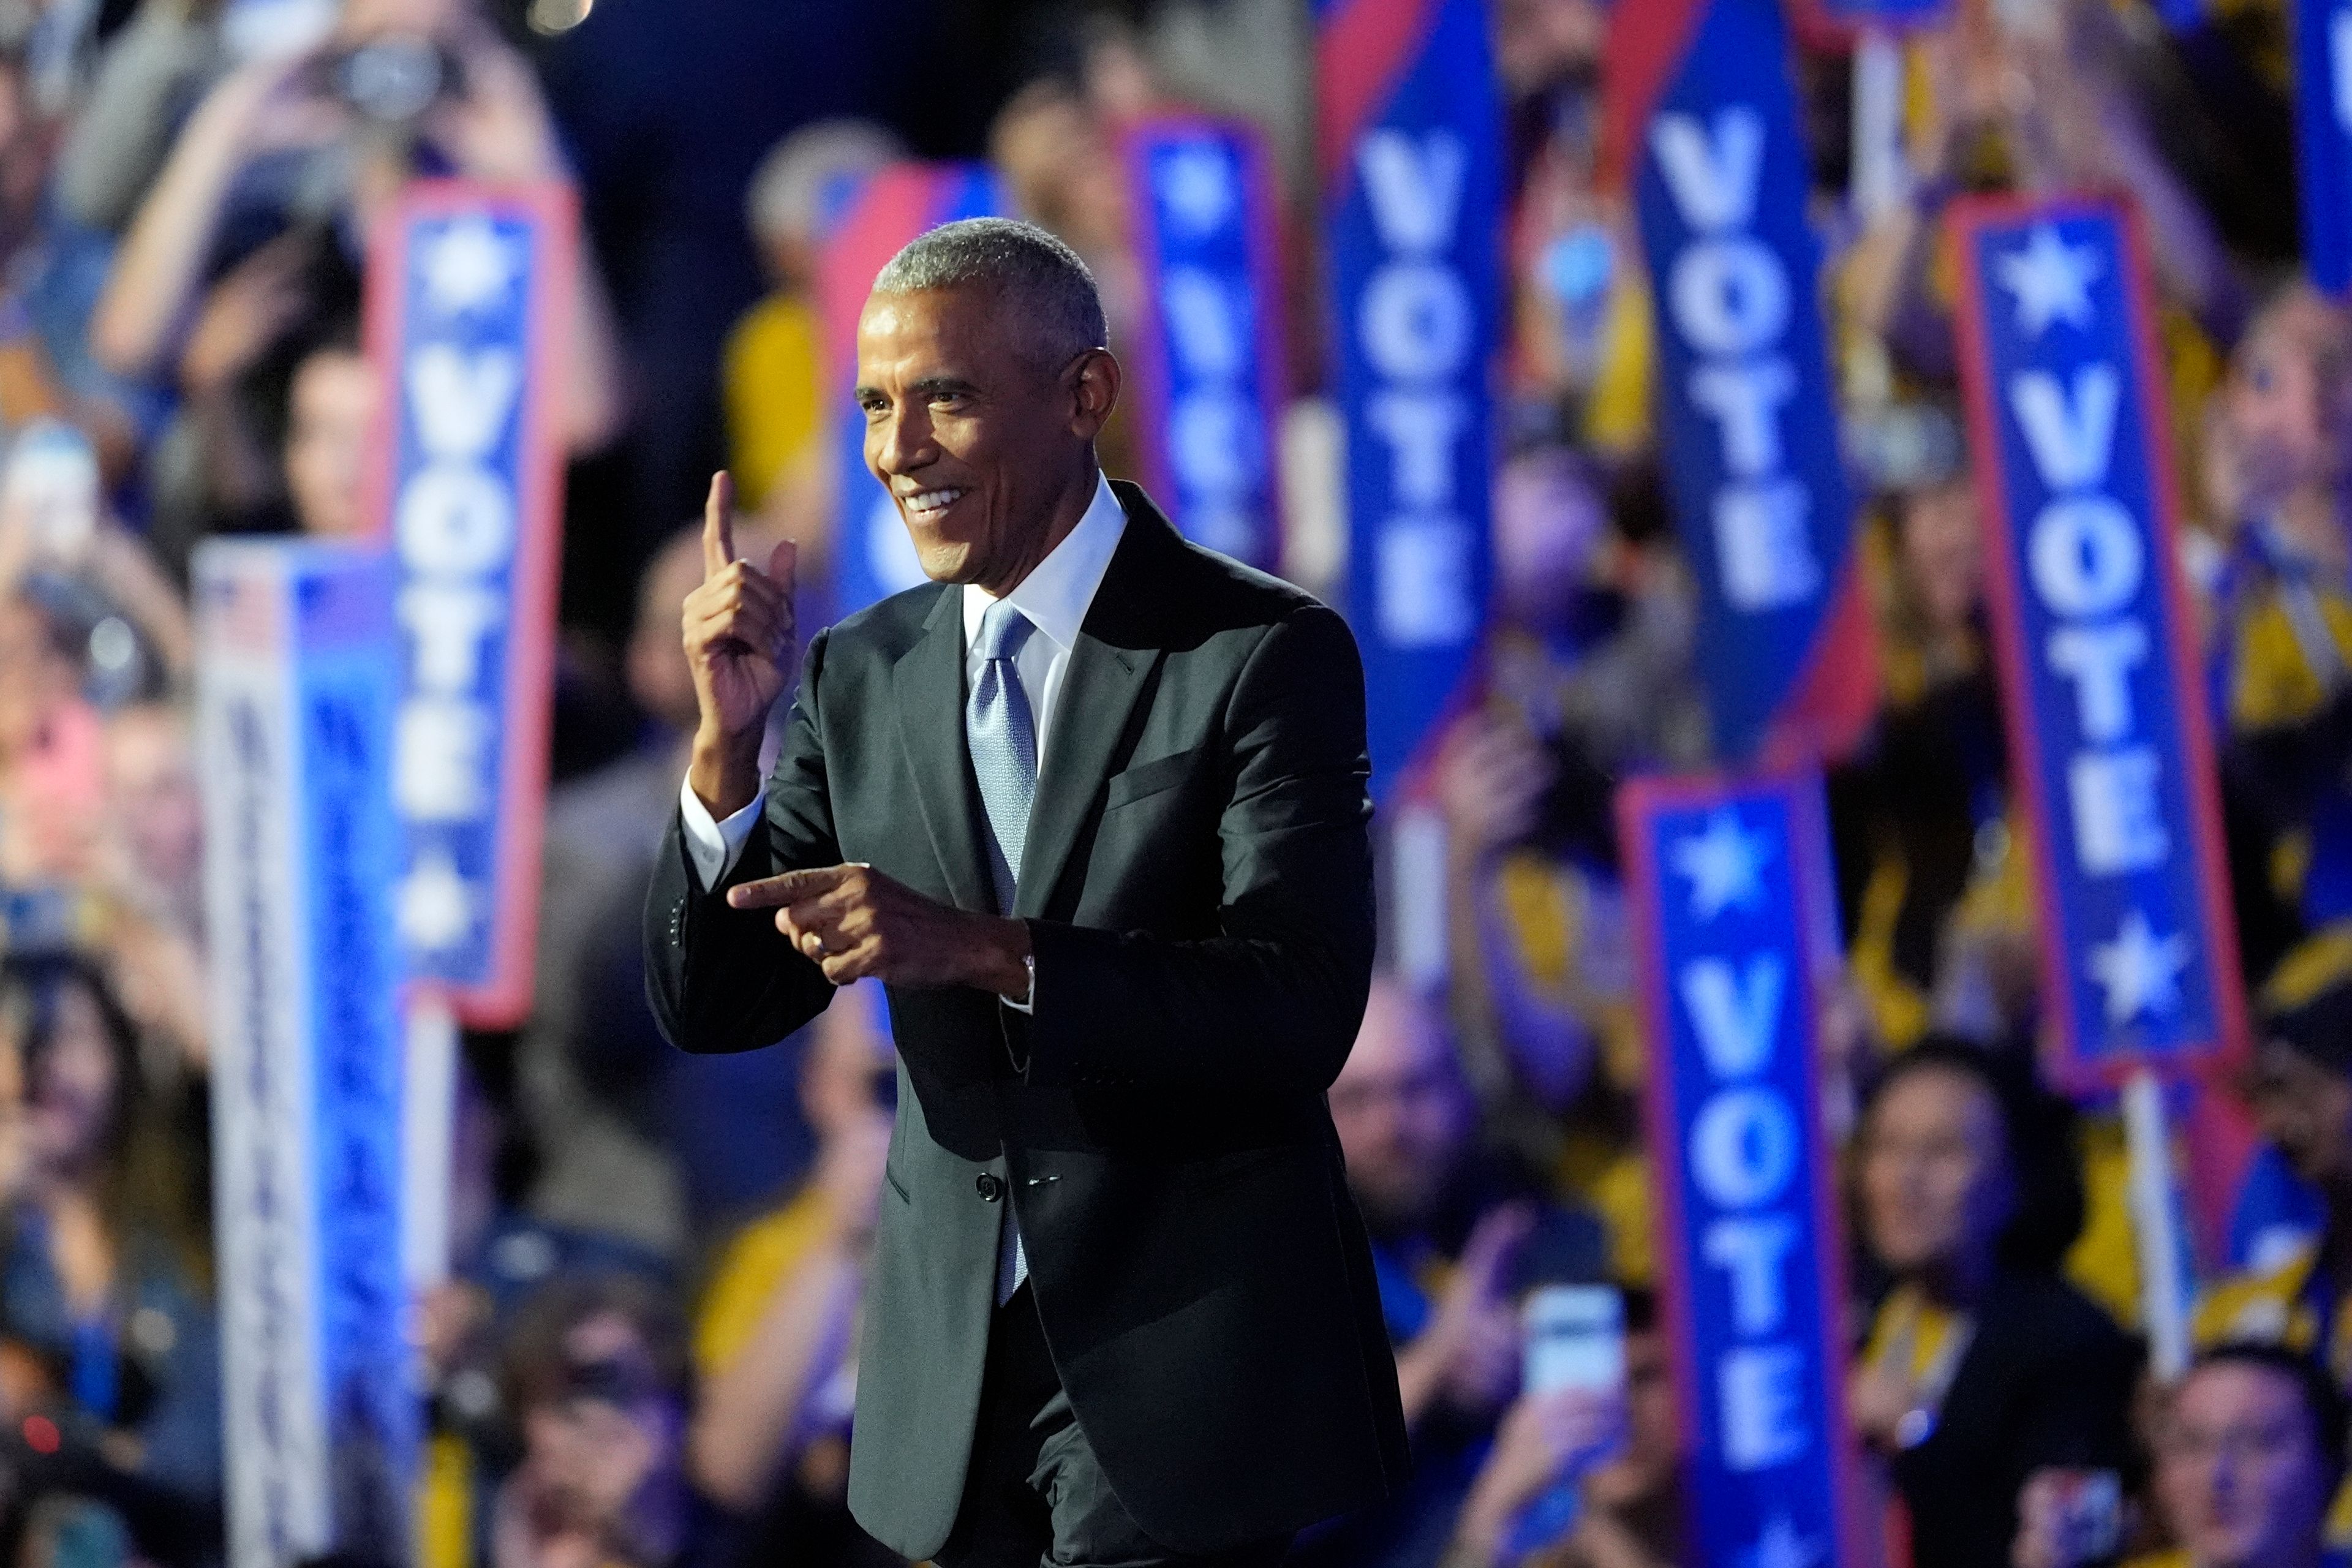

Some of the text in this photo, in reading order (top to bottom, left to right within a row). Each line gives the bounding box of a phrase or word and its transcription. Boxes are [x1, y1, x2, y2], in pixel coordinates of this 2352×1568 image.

[396, 343, 514, 818] VOTE
[1357, 130, 1475, 647] VOTE
[1653, 105, 1821, 610] VOTE
[2011, 368, 2169, 875] VOTE
[1681, 951, 1814, 1469] VOTE
